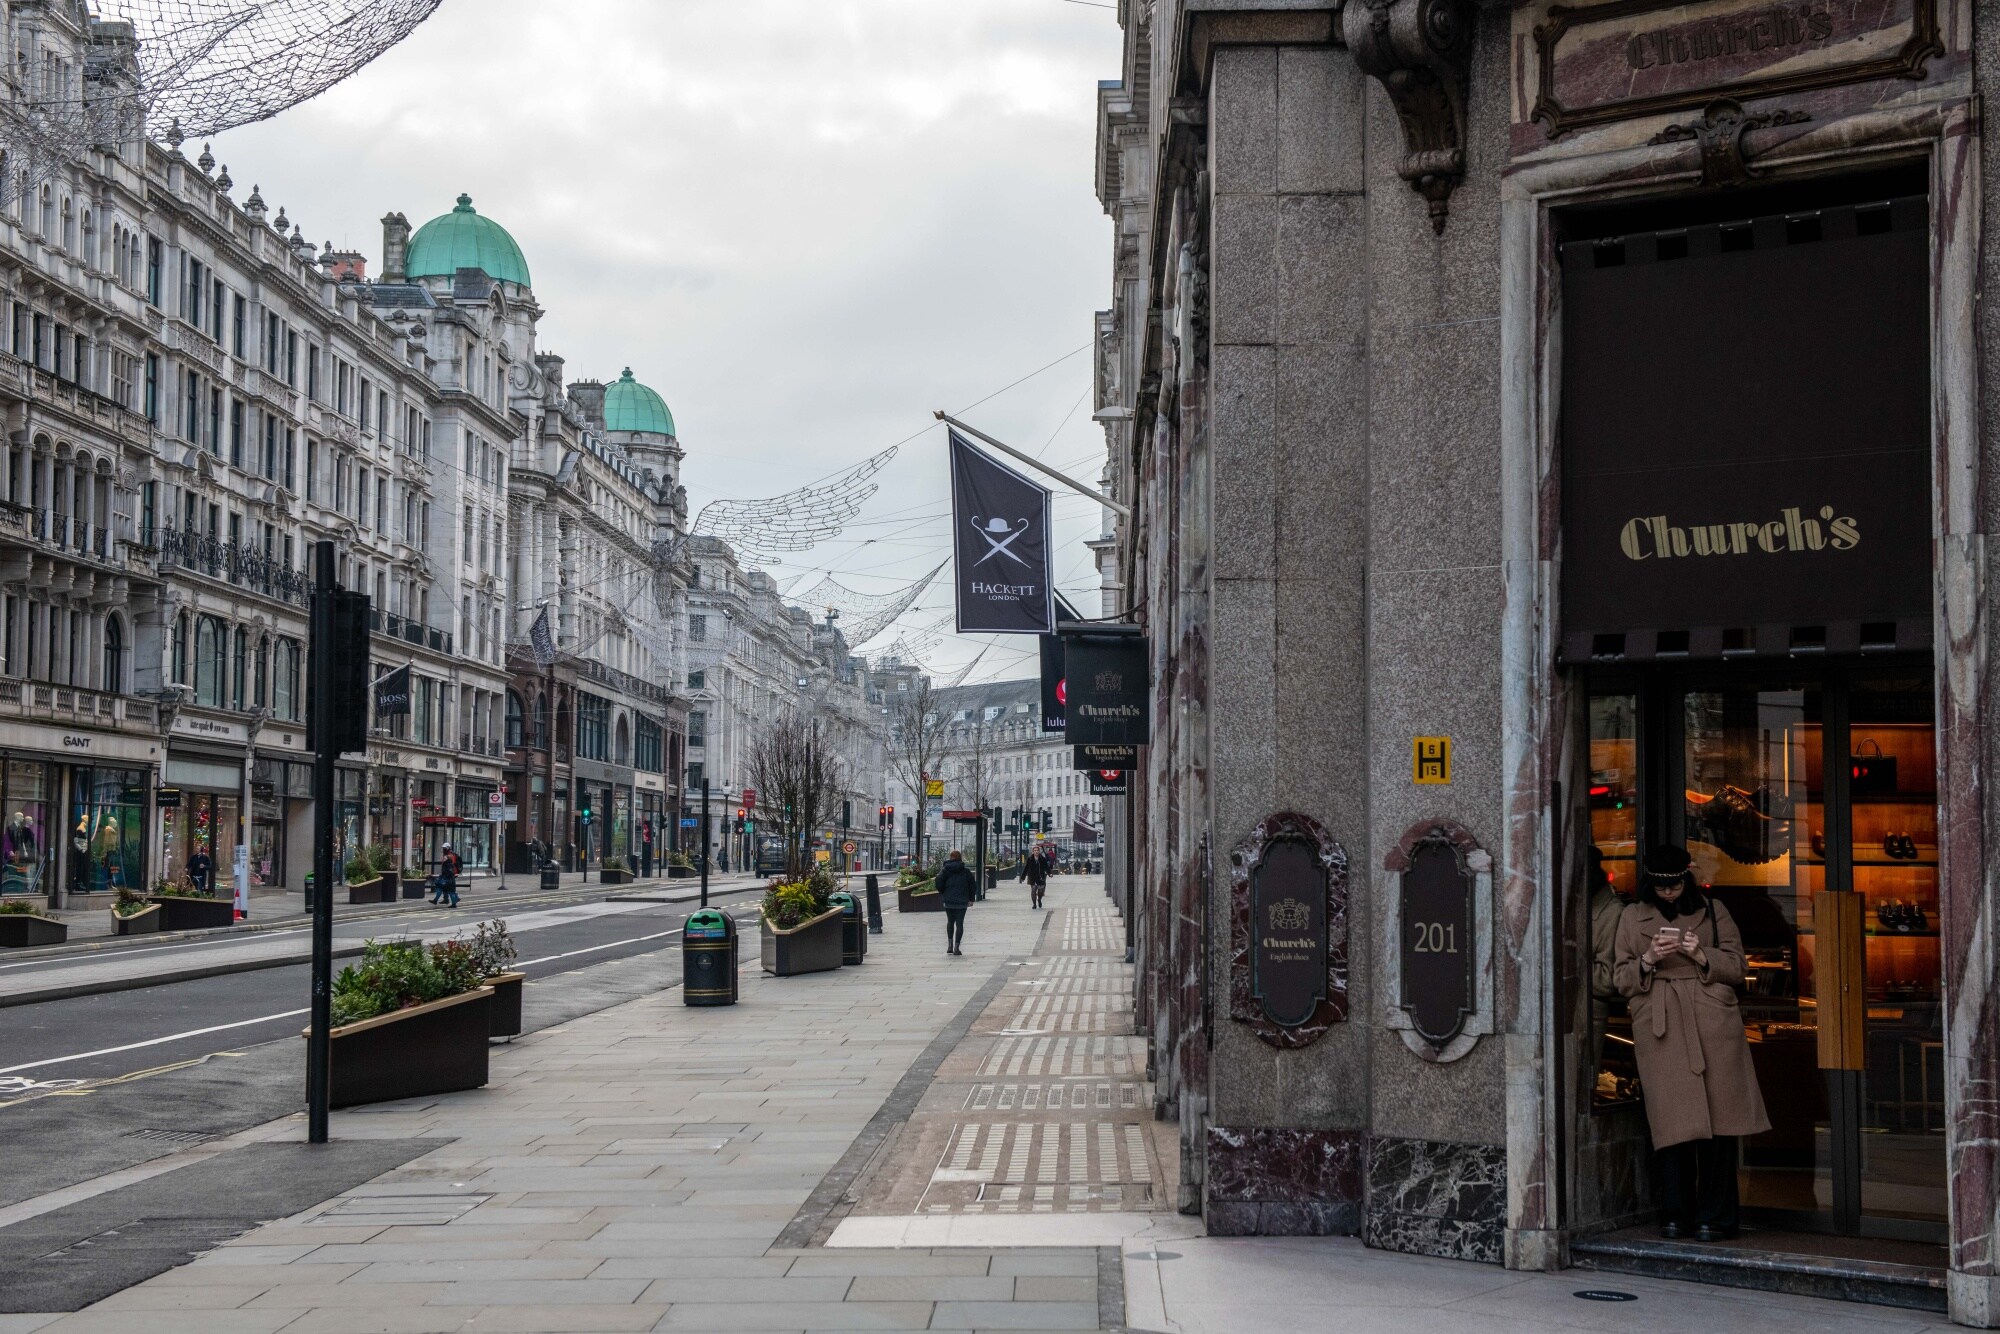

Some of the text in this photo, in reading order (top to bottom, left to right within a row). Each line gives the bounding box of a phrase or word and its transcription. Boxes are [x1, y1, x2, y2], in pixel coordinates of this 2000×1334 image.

[1626, 4, 1834, 70] Church's
[1620, 505, 1861, 561] Church's
[971, 582, 1035, 596] HACKETT
[380, 693, 408, 705] BOSS
[1079, 704, 1140, 716] Church's
[63, 735, 92, 748] GANT
[1085, 745, 1134, 755] Church's
[1429, 744, 1436, 755] 6
[1418, 741, 1446, 779] H
[1426, 765, 1438, 776] 15
[1093, 784, 1127, 792] lululemon
[1263, 937, 1316, 949] Church's
[1414, 921, 1458, 953] 201
[1270, 953, 1293, 963] English
